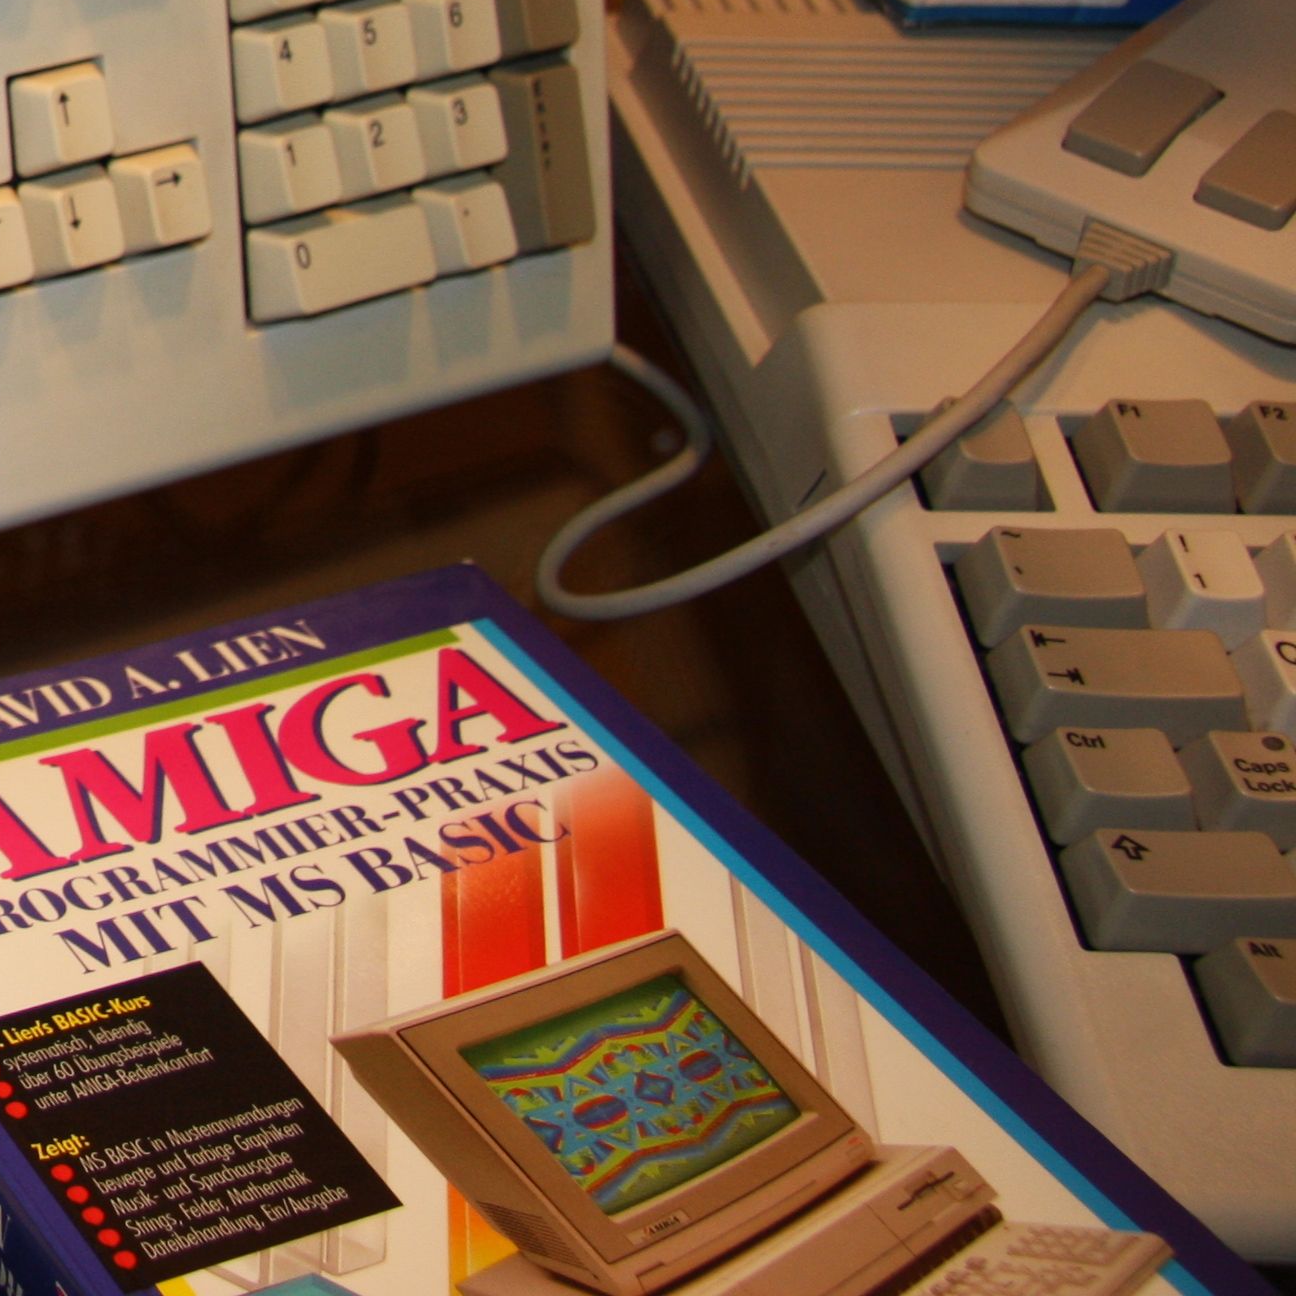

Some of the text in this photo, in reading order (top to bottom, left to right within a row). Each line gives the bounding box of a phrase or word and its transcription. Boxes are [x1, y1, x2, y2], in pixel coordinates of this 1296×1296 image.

[449, 2, 462, 28] 6
[363, 20, 377, 46] 5
[279, 39, 293, 63] 4
[453, 98, 468, 126] 3
[369, 122, 385, 148] 2
[286, 143, 296, 167] 1
[295, 243, 311, 269] 0
[1116, 403, 1142, 420] F1
[1259, 405, 1288, 422] F2
[128, 662, 183, 704] A.
[174, 619, 327, 685] LIEN
[1066, 731, 1106, 750] Ctrl
[1234, 757, 1290, 775] Caps
[54, 798, 572, 975] MIT MS BASIC
[1248, 941, 1282, 959] Alt
[3, 1019, 54, 1046] Lien's
[52, 995, 151, 1031] BASIC-Kurs
[3, 1018, 153, 1073] systematisch, lebendig
[19, 1031, 183, 1090] über 60 Übungsbeispiele
[34, 1046, 214, 1110] unter AMIGA-Bedienkomfort
[31, 1134, 91, 1161] Zeigt:
[79, 1096, 304, 1174] MS BASIC in Musteranwendungen
[92, 1121, 304, 1195] bewegte und farbige Graphiken
[110, 1149, 293, 1217] Musik- und Sprachausgabe
[125, 1169, 313, 1239] Strings, Felder, Mathematik
[141, 1184, 349, 1261] Dateibehandlung, Ein/Ausgabe
